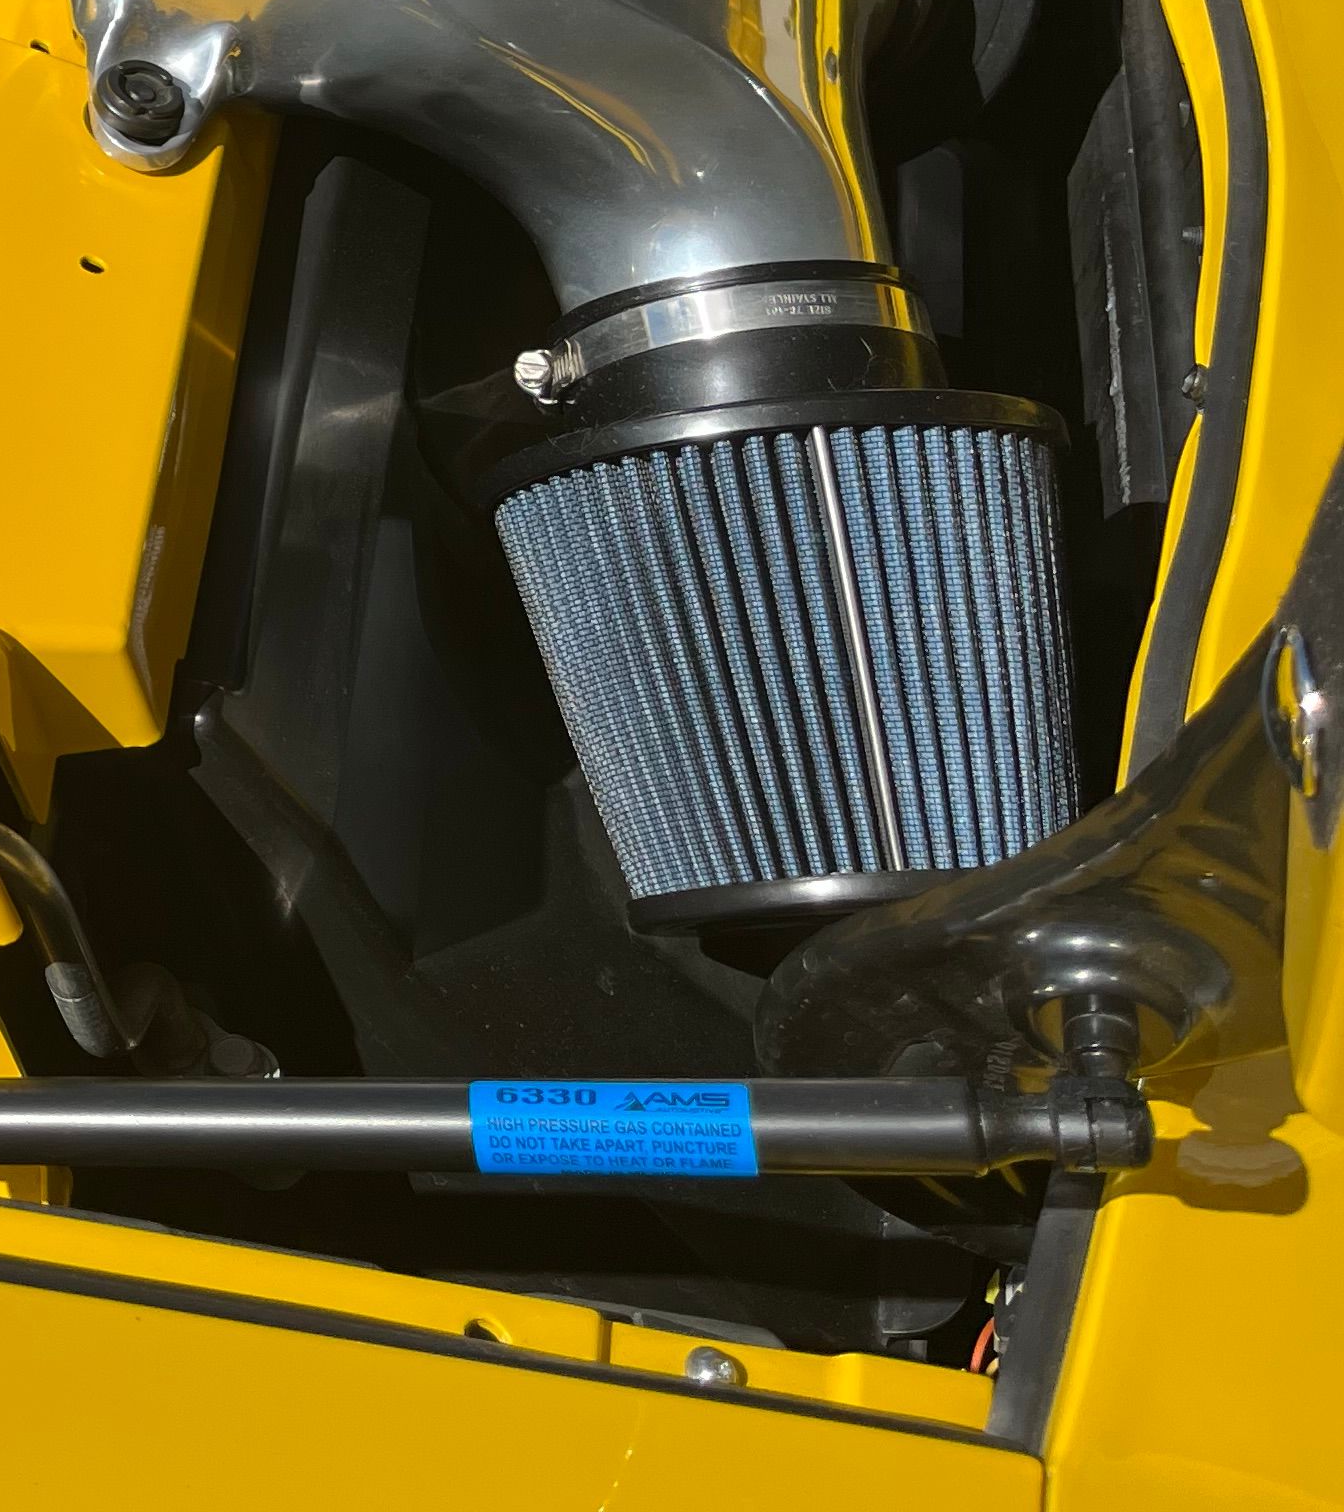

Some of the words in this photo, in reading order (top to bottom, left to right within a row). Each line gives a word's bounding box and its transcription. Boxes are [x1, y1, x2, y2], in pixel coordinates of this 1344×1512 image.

[496, 1087, 597, 1106] 6330
[643, 1091, 730, 1107] AMS
[487, 1117, 524, 1133] HIGH
[528, 1117, 610, 1135] PRESSURE
[614, 1120, 647, 1136] GAS
[651, 1121, 742, 1137] CONTAINED
[489, 1136, 511, 1150] DO
[515, 1136, 547, 1151] NOT
[551, 1138, 592, 1152] TAKE
[652, 1141, 737, 1155] PUNCTURE
[492, 1152, 514, 1165] OR
[518, 1152, 579, 1166] EXPOSE
[584, 1154, 604, 1167] TO
[609, 1155, 648, 1168] HEAT
[653, 1156, 675, 1168] OR
[680, 1157, 733, 1170] FLAME
